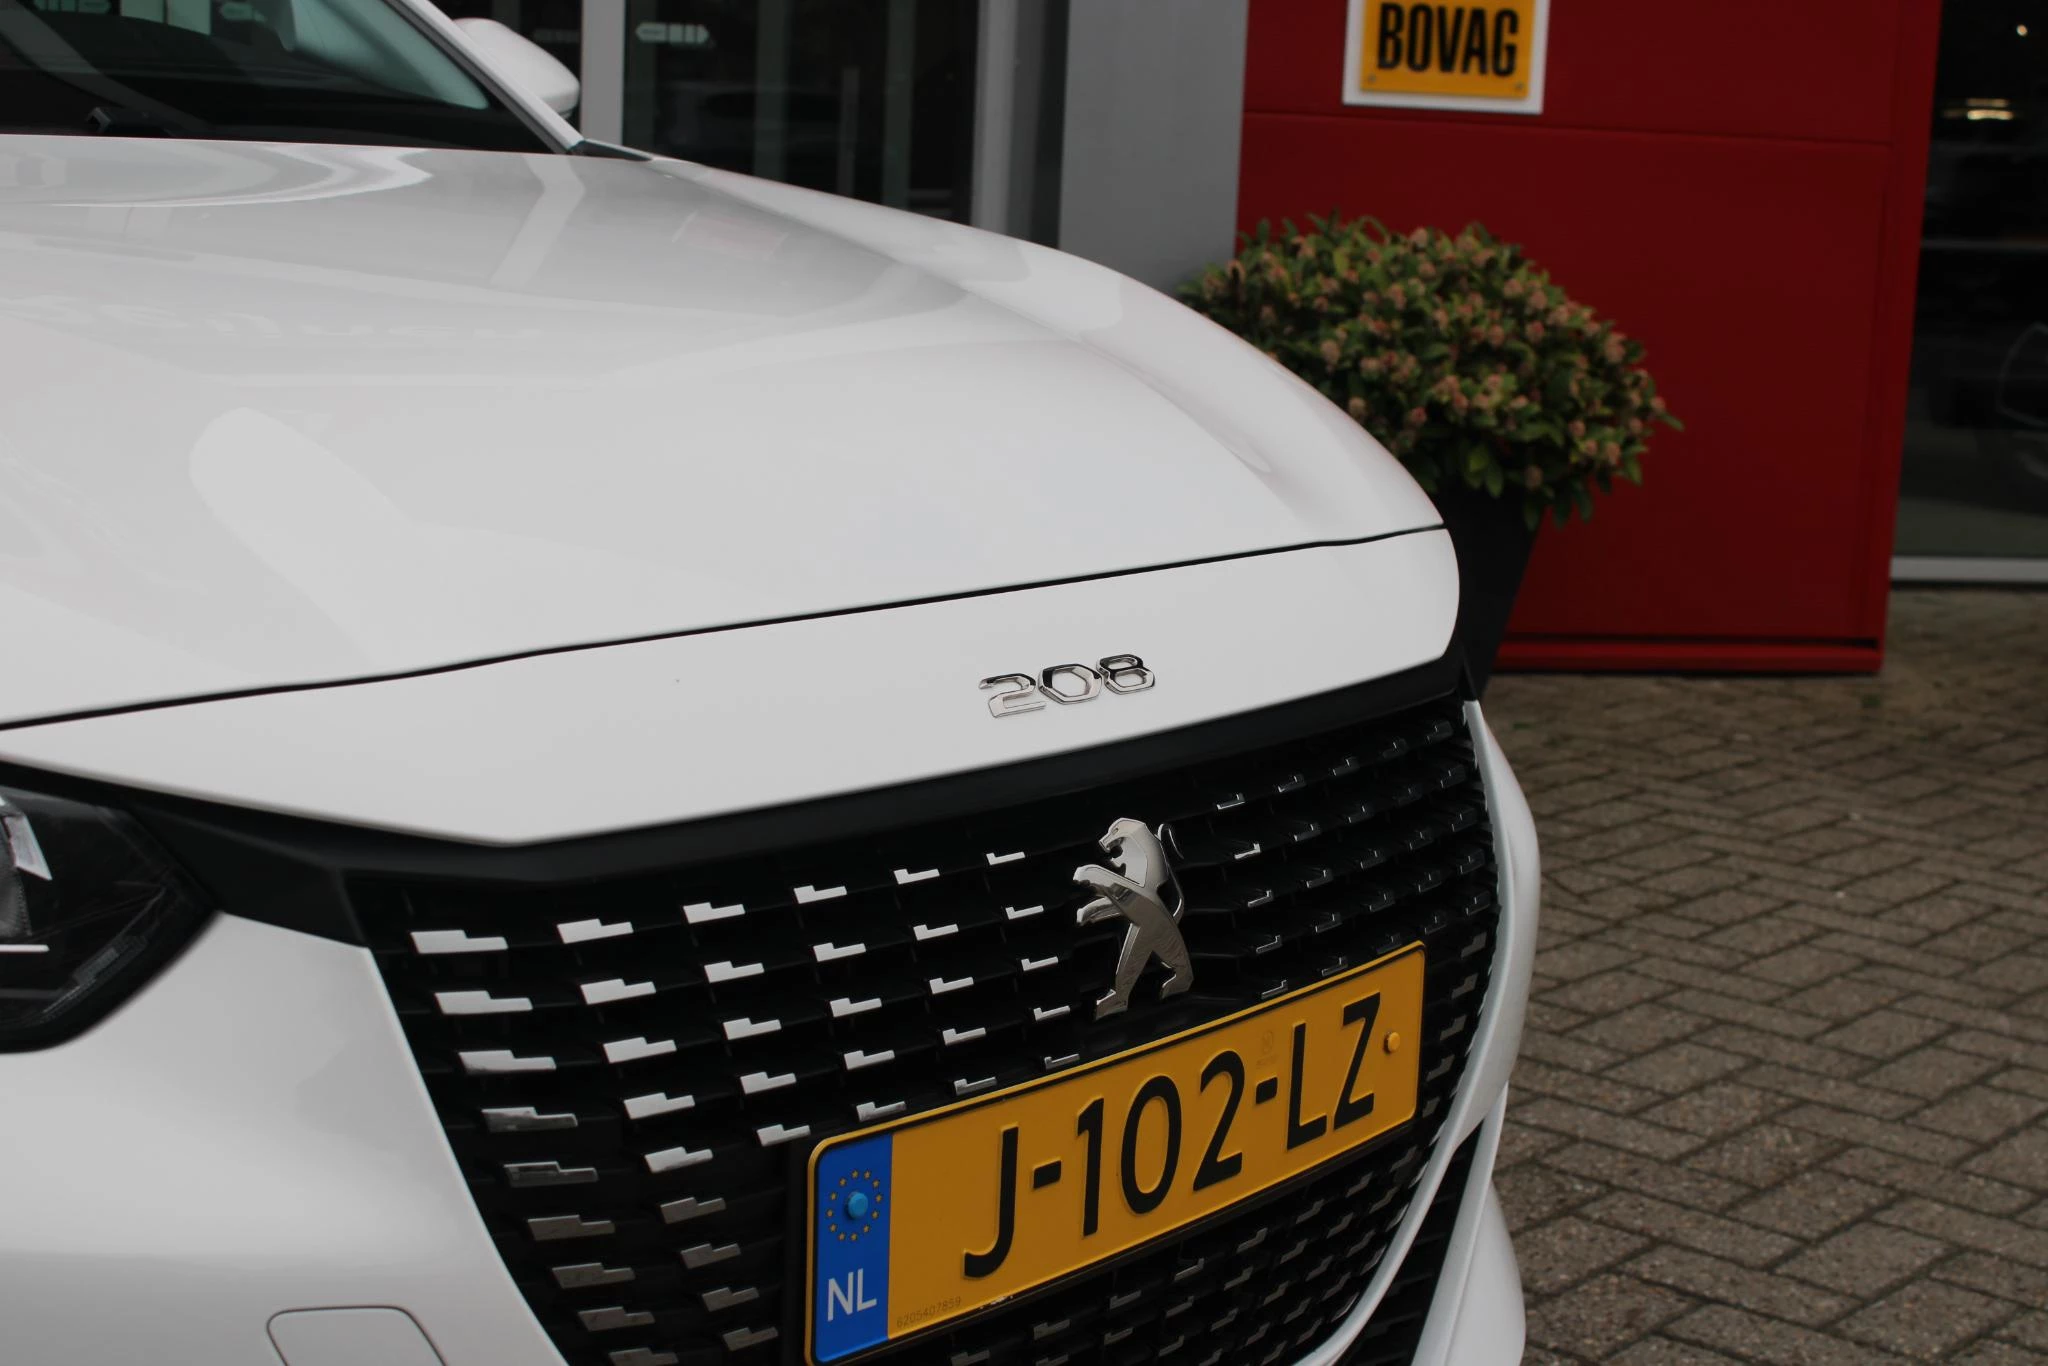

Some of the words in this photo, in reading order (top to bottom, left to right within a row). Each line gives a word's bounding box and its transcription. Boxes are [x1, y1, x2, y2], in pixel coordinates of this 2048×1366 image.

[1377, 3, 1519, 77] BOVAG
[979, 654, 1155, 718] 208
[964, 992, 1381, 1278] J-102-LZ
[827, 1268, 877, 1322] NL
